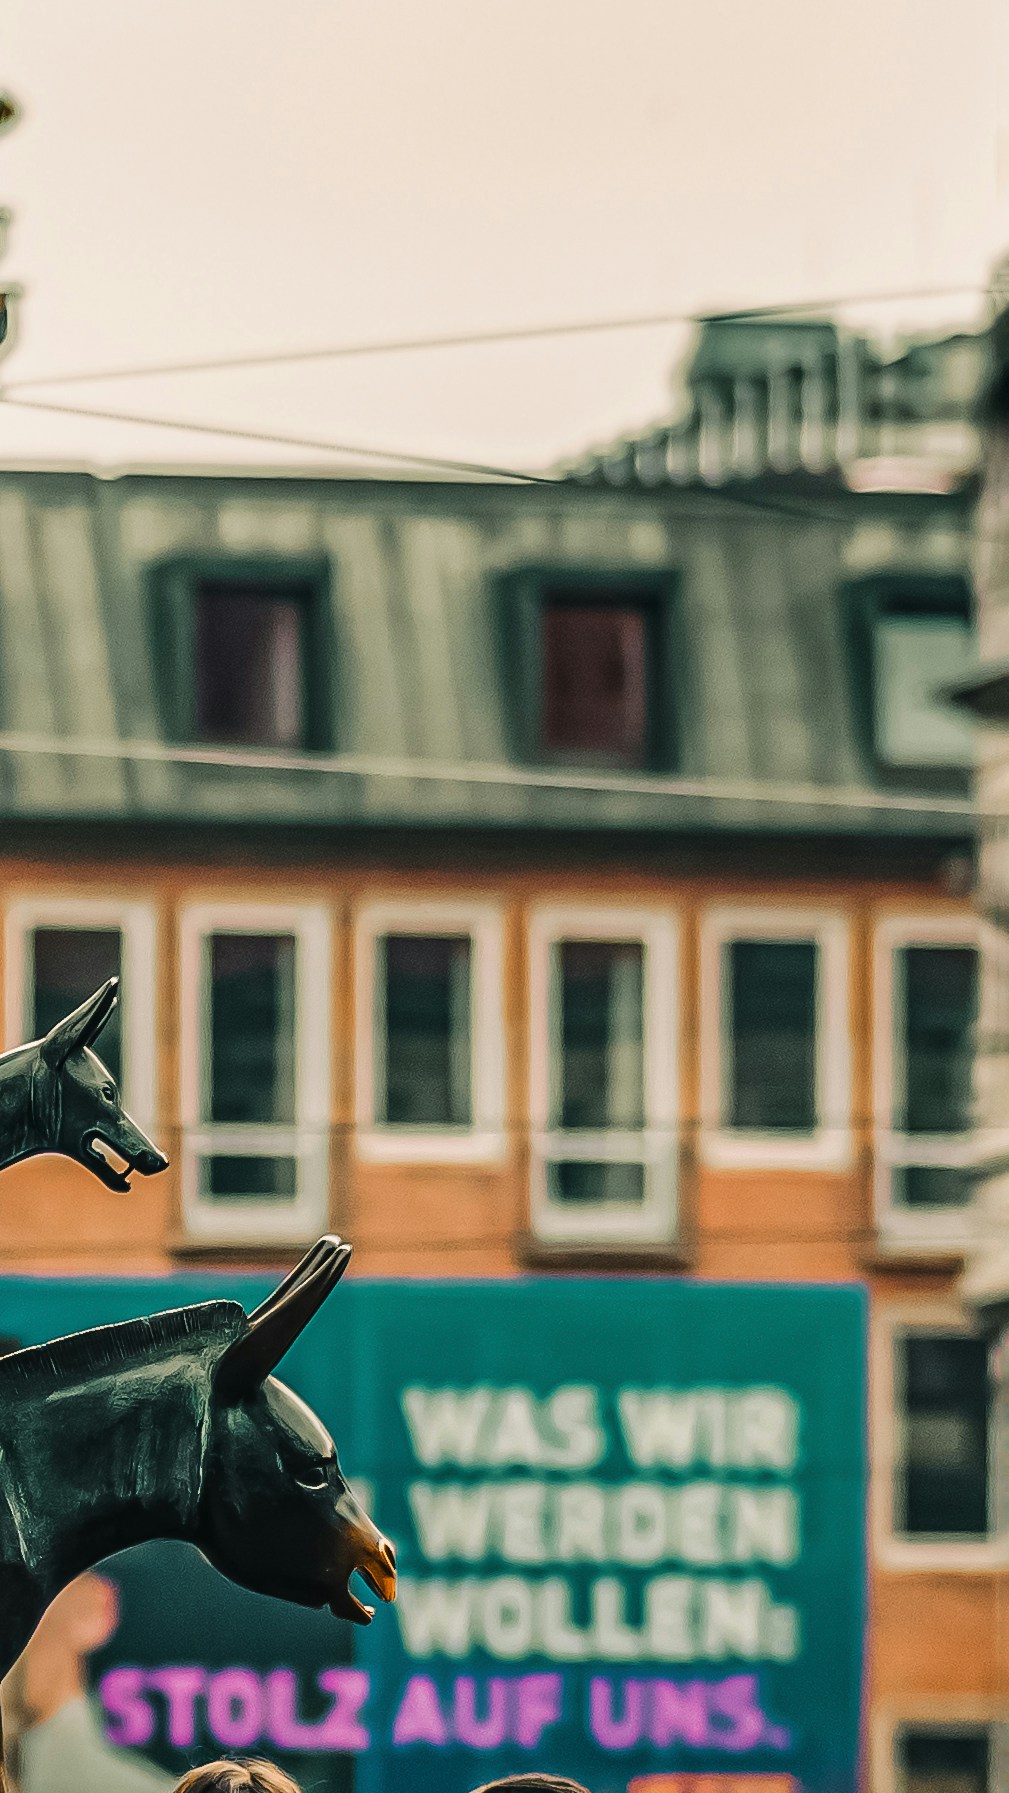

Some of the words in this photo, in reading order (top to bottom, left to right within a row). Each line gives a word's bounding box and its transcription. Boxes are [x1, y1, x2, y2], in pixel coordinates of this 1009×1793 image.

[402, 1386, 603, 1469] WAS
[618, 1386, 798, 1469] WIR
[409, 1481, 799, 1566] WERDEN
[99, 1666, 371, 1750] STOLZ
[393, 1673, 561, 1749] AUF
[591, 1674, 789, 1750] UNS.
